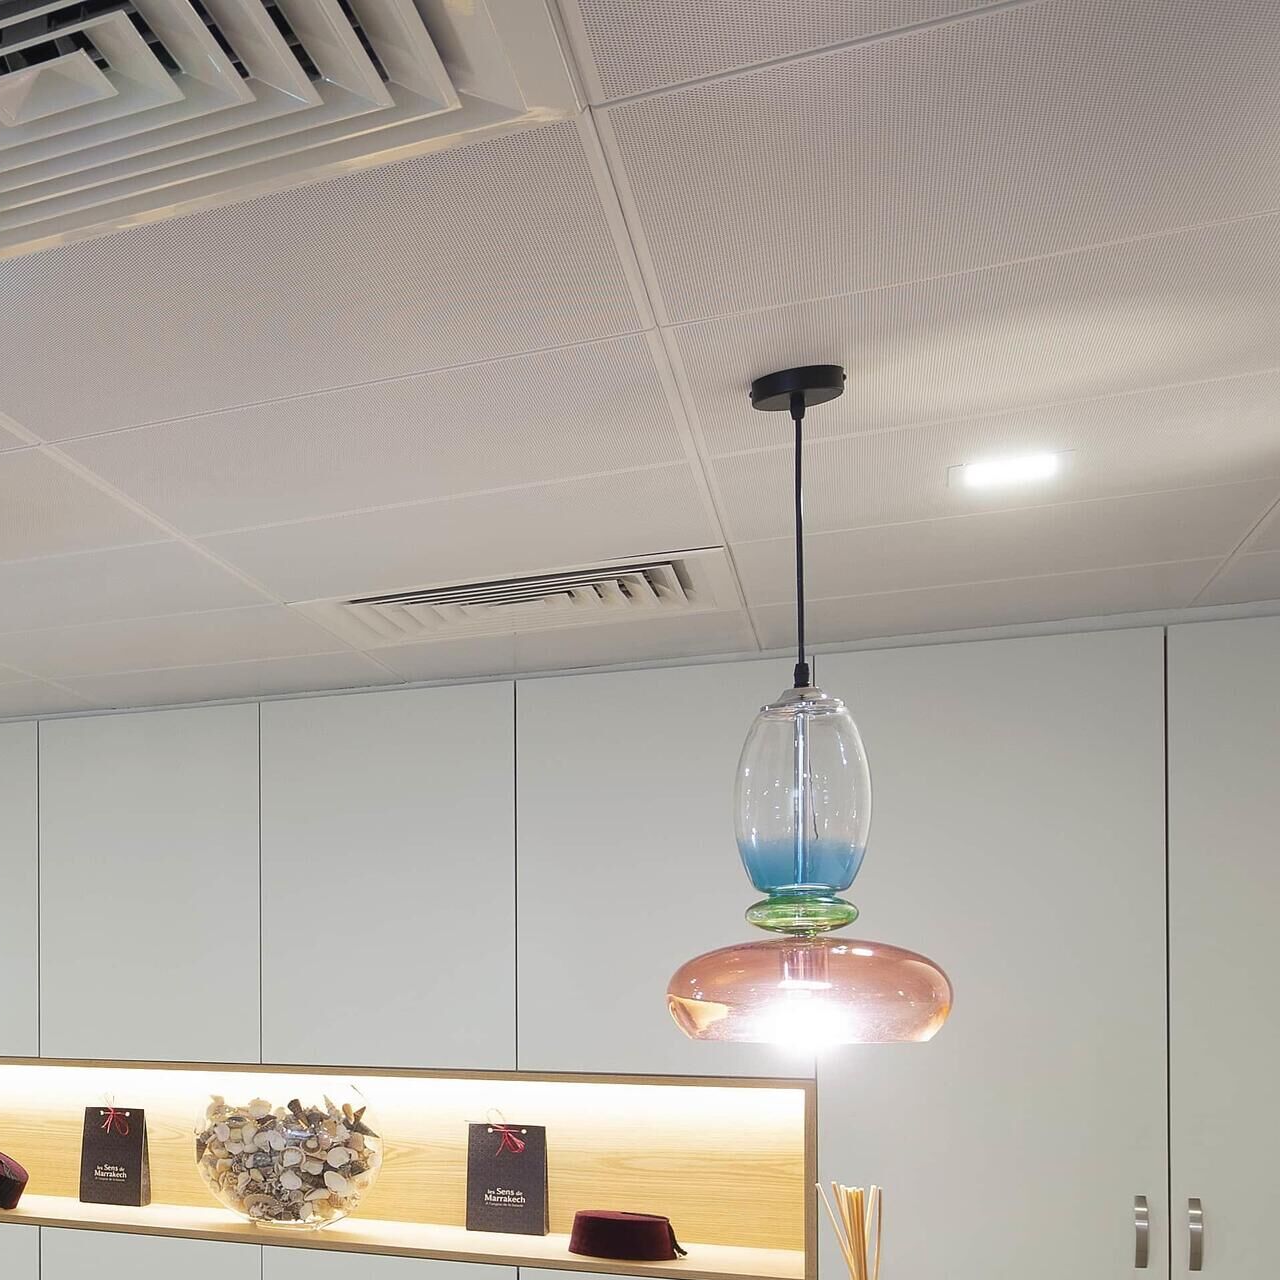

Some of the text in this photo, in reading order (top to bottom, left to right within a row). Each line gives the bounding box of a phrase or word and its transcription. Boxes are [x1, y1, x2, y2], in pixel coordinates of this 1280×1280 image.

[94, 1169, 127, 1178] Marrakech
[496, 1187, 514, 1196] Sens
[484, 1193, 526, 1203] Marrakech
